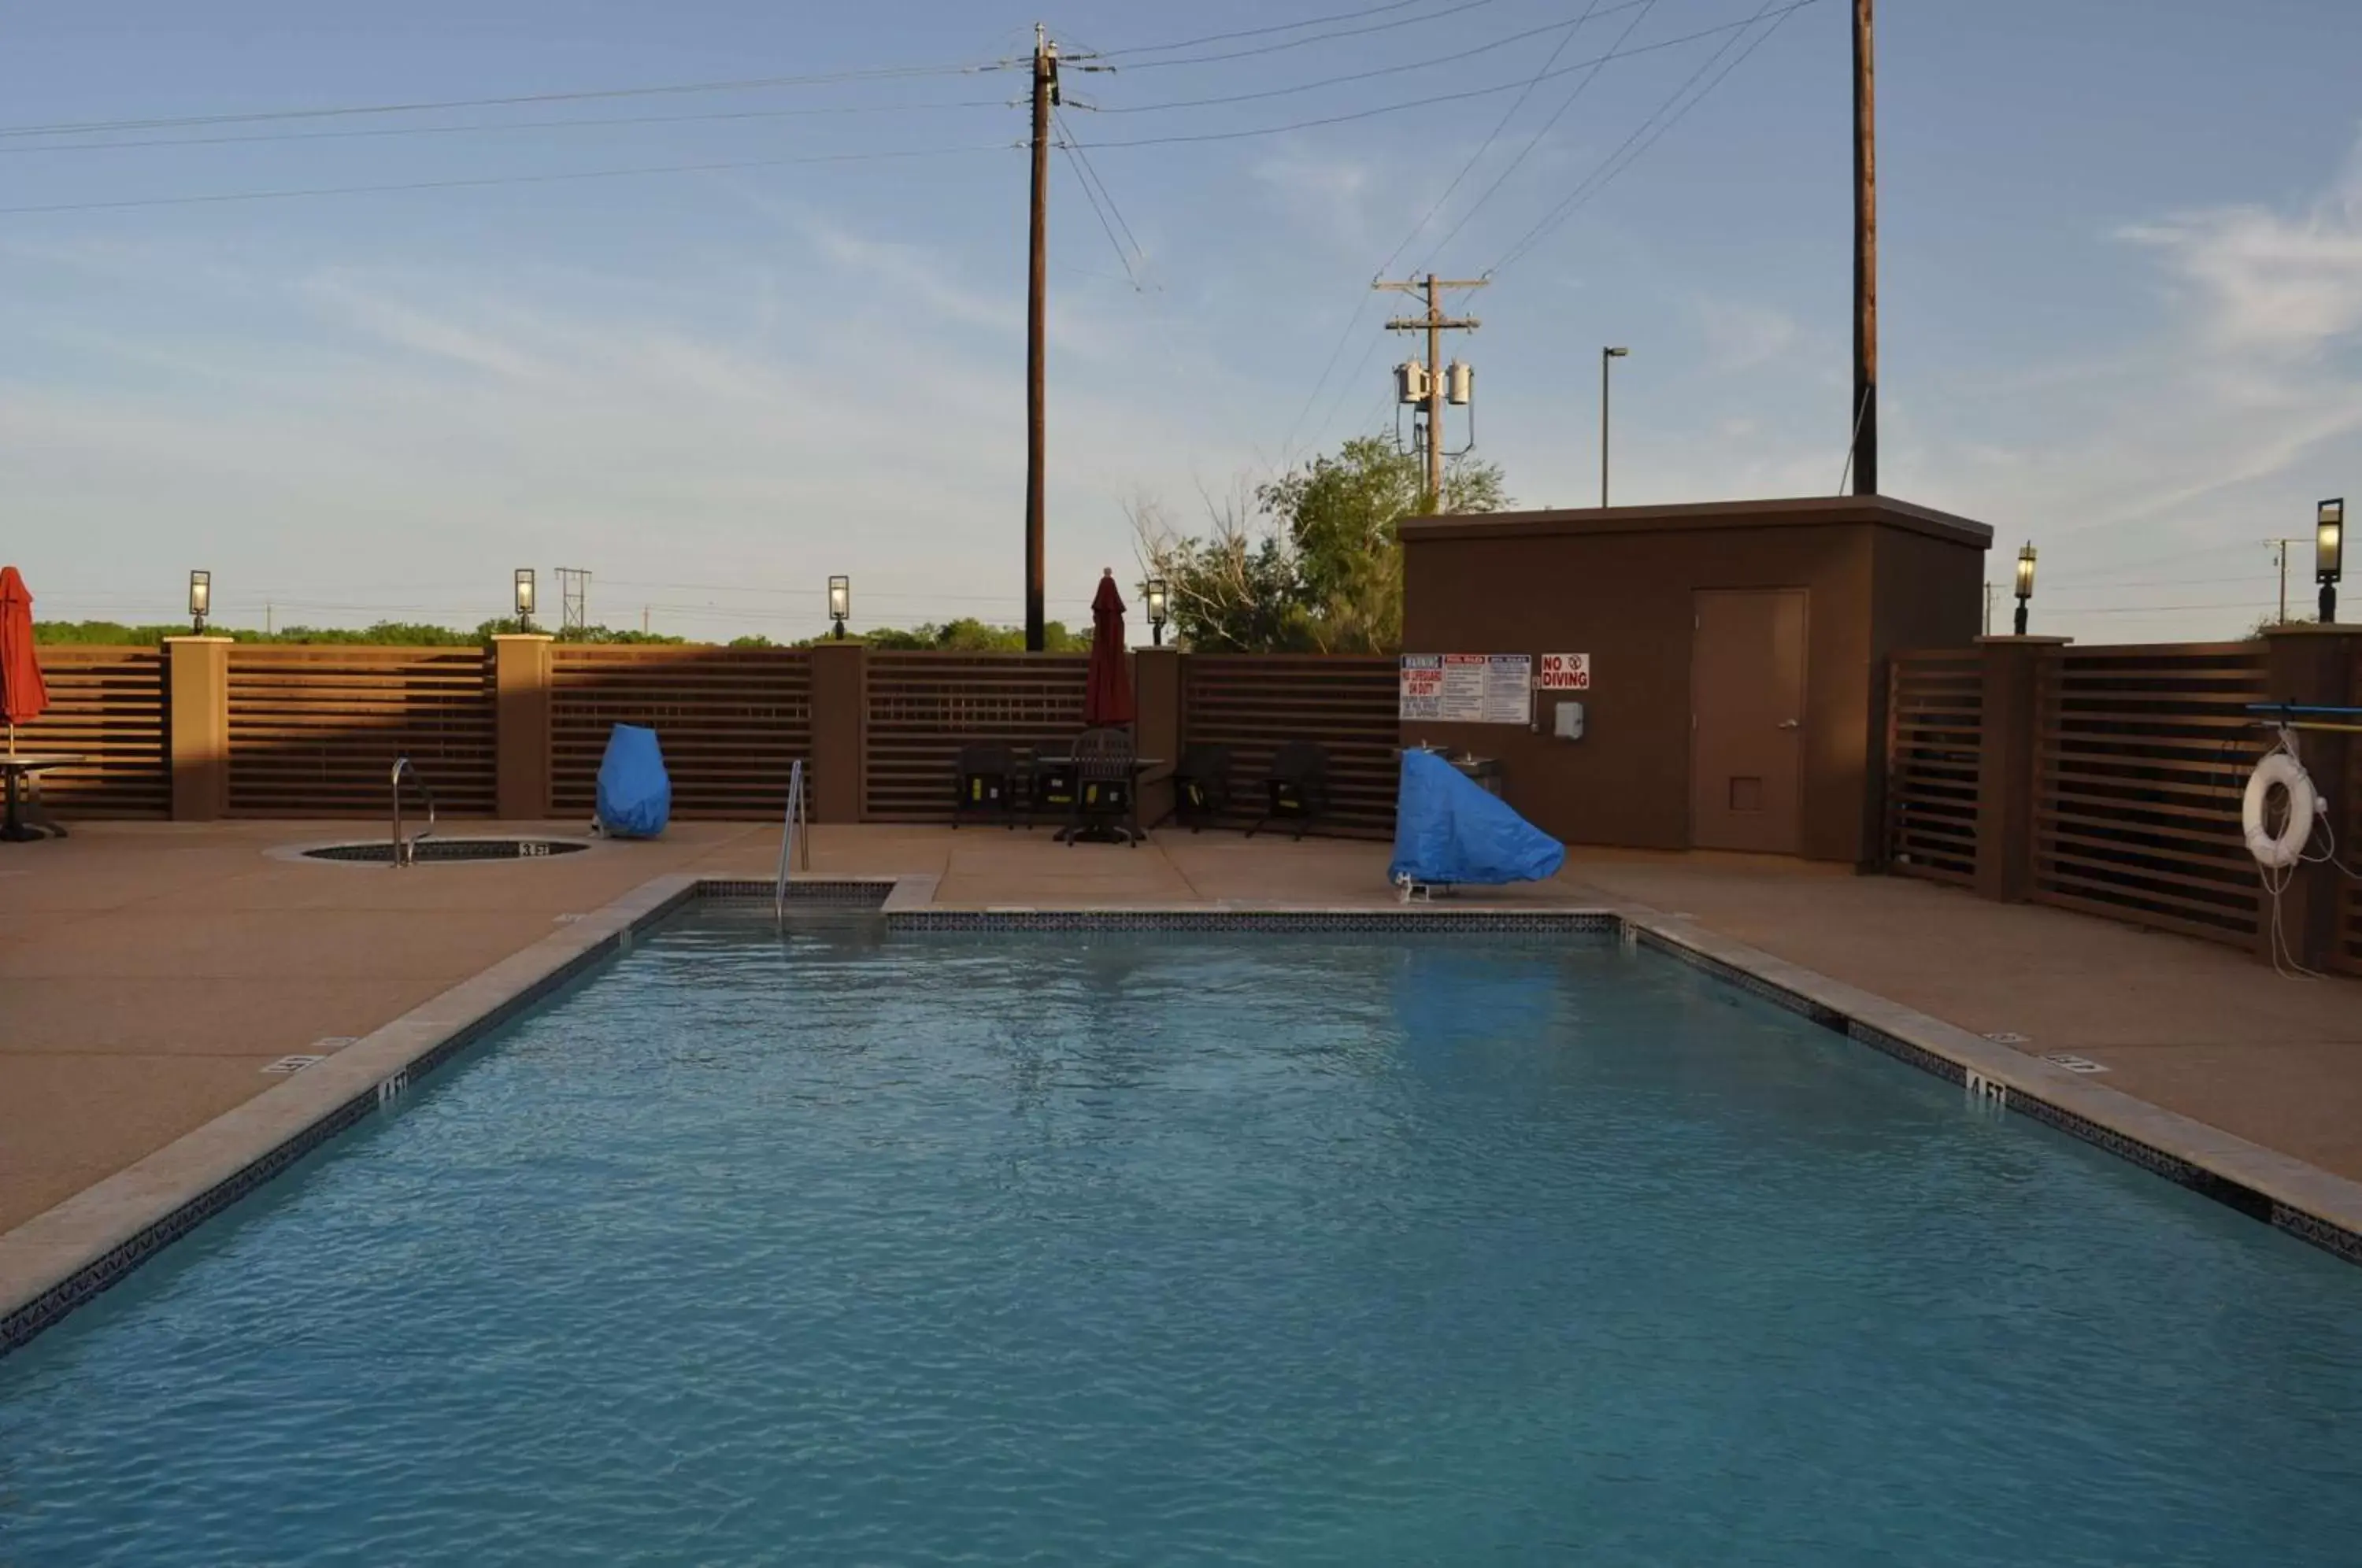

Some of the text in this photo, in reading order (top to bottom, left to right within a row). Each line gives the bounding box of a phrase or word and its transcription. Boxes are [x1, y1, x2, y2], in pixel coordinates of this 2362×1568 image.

[1544, 656, 1561, 671] NO
[1544, 672, 1587, 686] DIVING
[1986, 1082, 2004, 1104] FT
